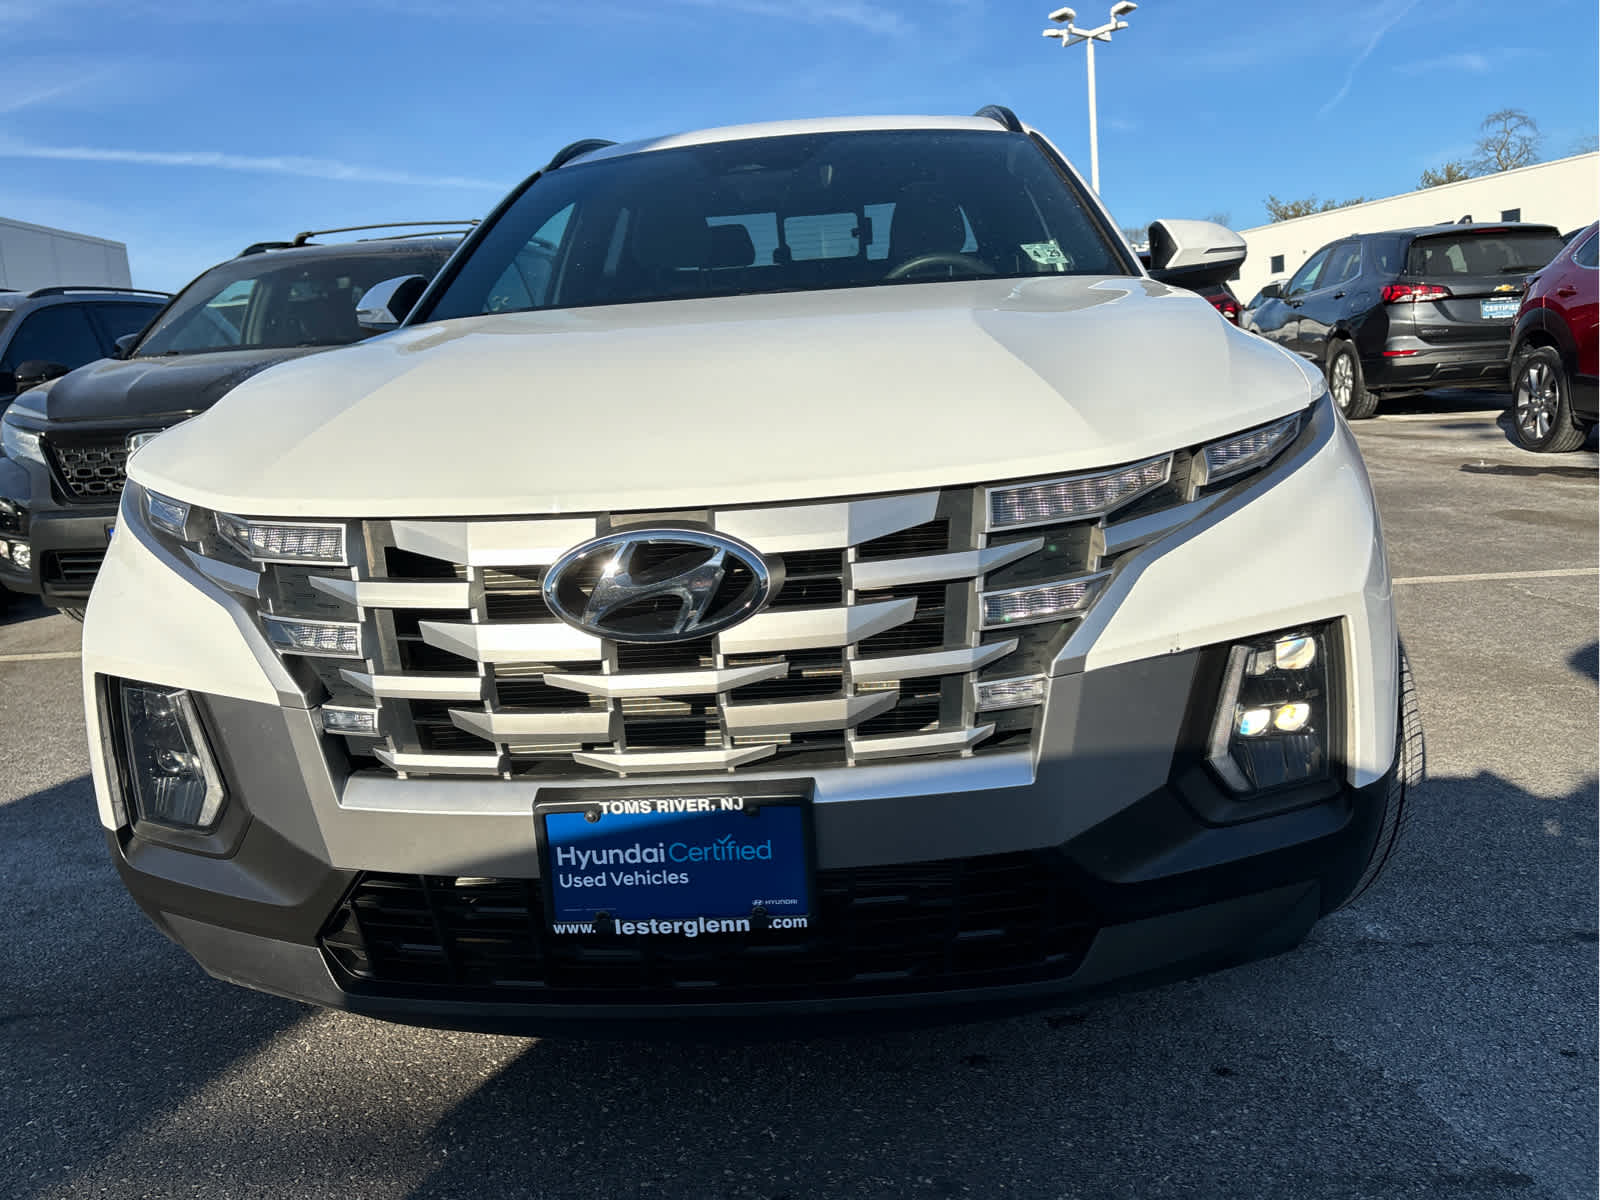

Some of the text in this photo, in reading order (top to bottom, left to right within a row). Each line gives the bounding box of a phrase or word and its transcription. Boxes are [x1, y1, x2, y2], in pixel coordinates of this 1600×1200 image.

[600, 797, 744, 815] TOMS RIVER, NJ
[556, 836, 773, 870] Hyundai Certified
[559, 869, 689, 888] Used Vehicles
[614, 916, 751, 938] lesterglenn
[768, 916, 808, 930] .com
